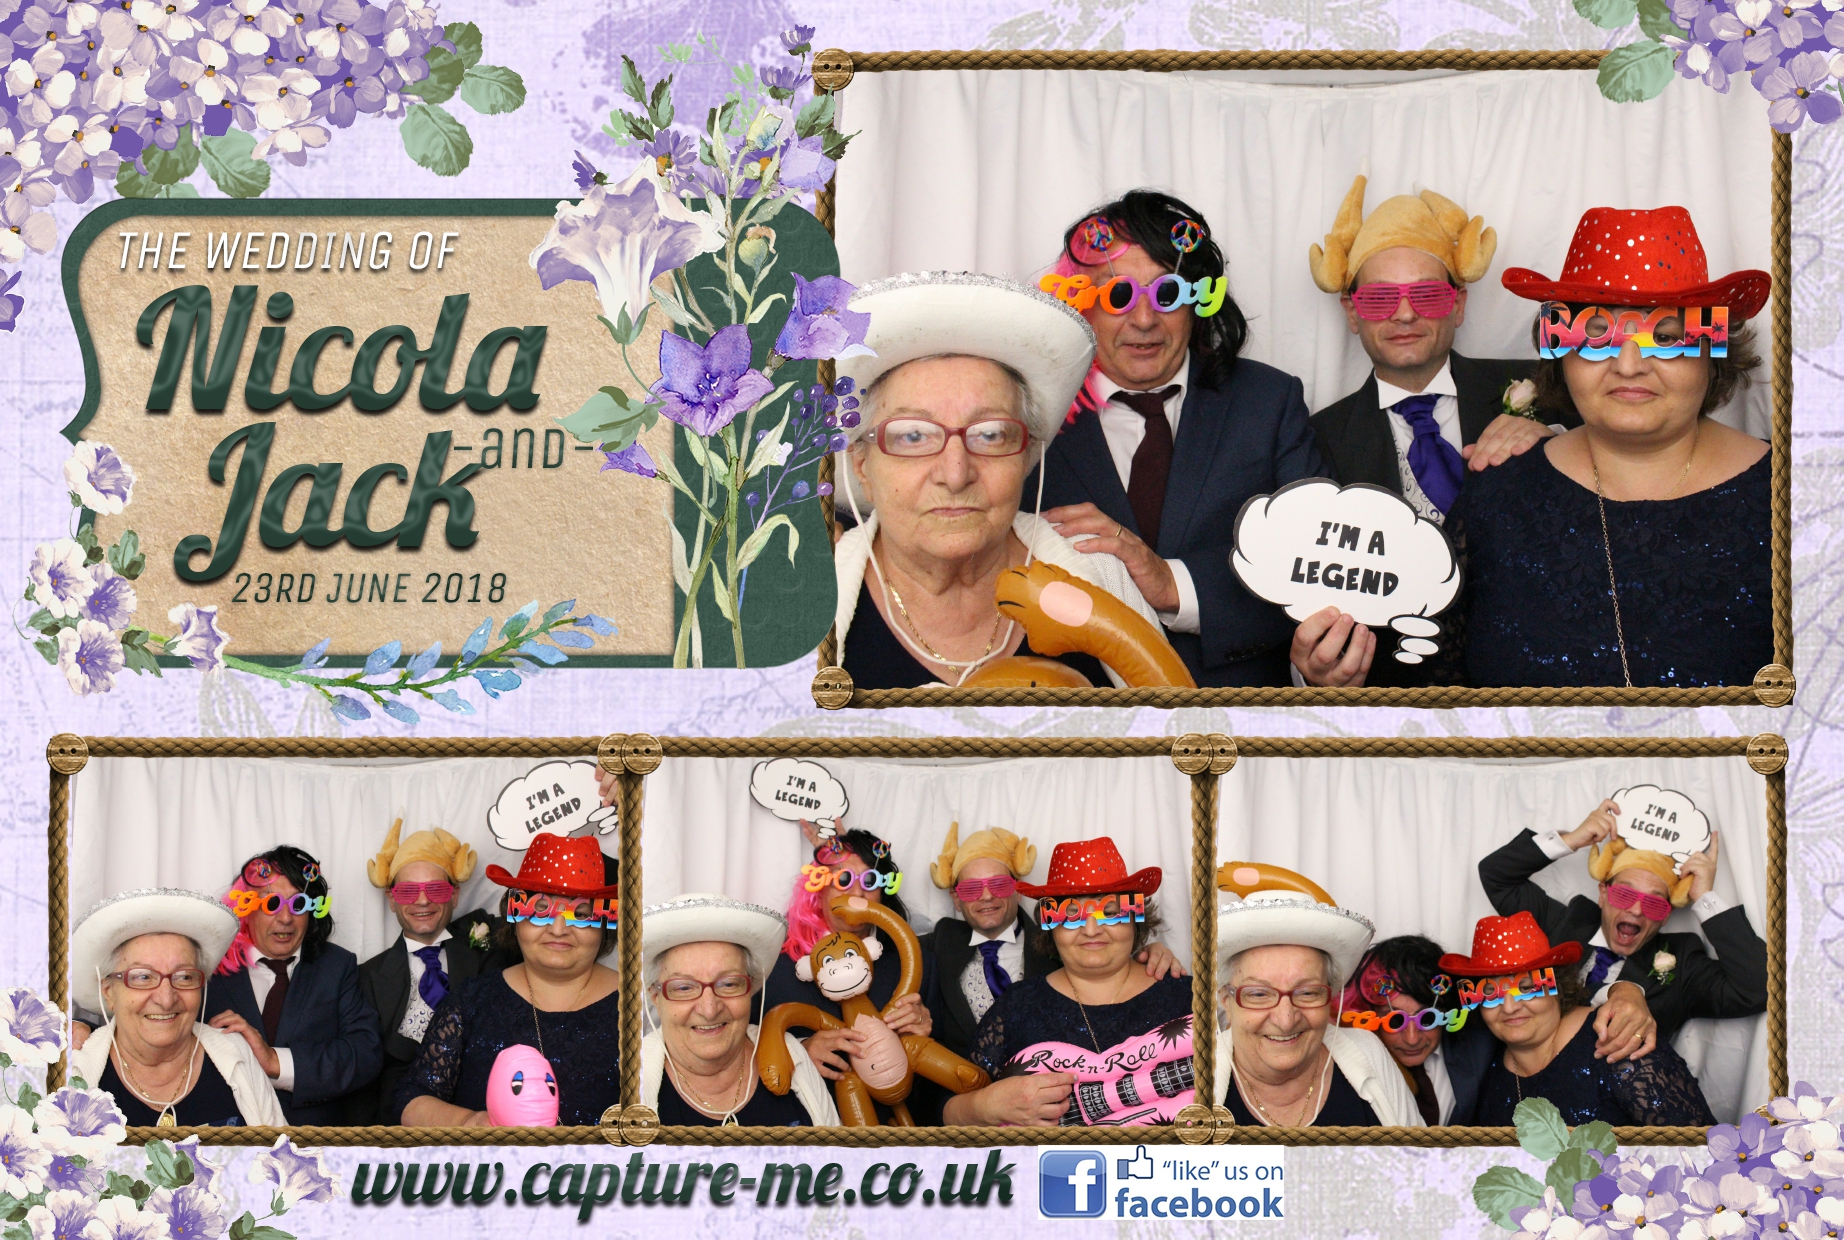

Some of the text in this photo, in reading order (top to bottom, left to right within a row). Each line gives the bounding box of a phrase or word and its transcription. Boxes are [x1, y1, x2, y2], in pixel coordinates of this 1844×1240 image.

[1315, 520, 1386, 556] I'M A
[1290, 556, 1400, 598] LEGEND
[525, 782, 566, 811] I'M A
[786, 774, 817, 793] I'M A
[774, 789, 822, 811] LEGEND
[1644, 803, 1678, 824] I'M A
[524, 797, 582, 835] LEGEND
[1630, 817, 1681, 843] LEGEND
